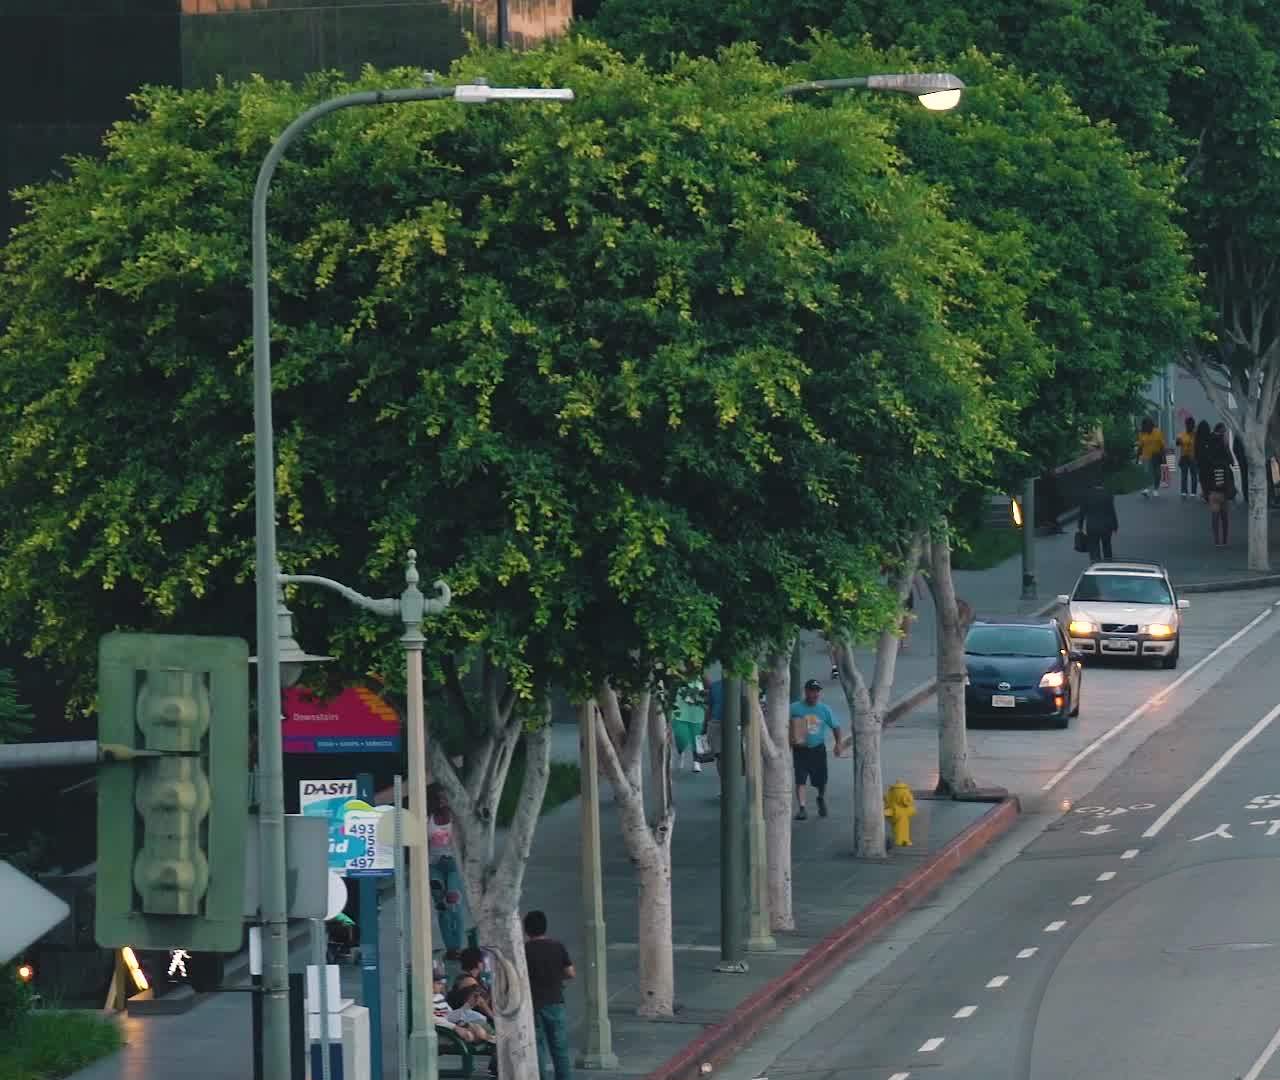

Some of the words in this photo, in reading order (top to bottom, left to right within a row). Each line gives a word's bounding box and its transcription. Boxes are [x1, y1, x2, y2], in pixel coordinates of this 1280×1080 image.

[304, 782, 352, 795] DASH
[349, 824, 375, 834] 493
[349, 858, 375, 868] 497
